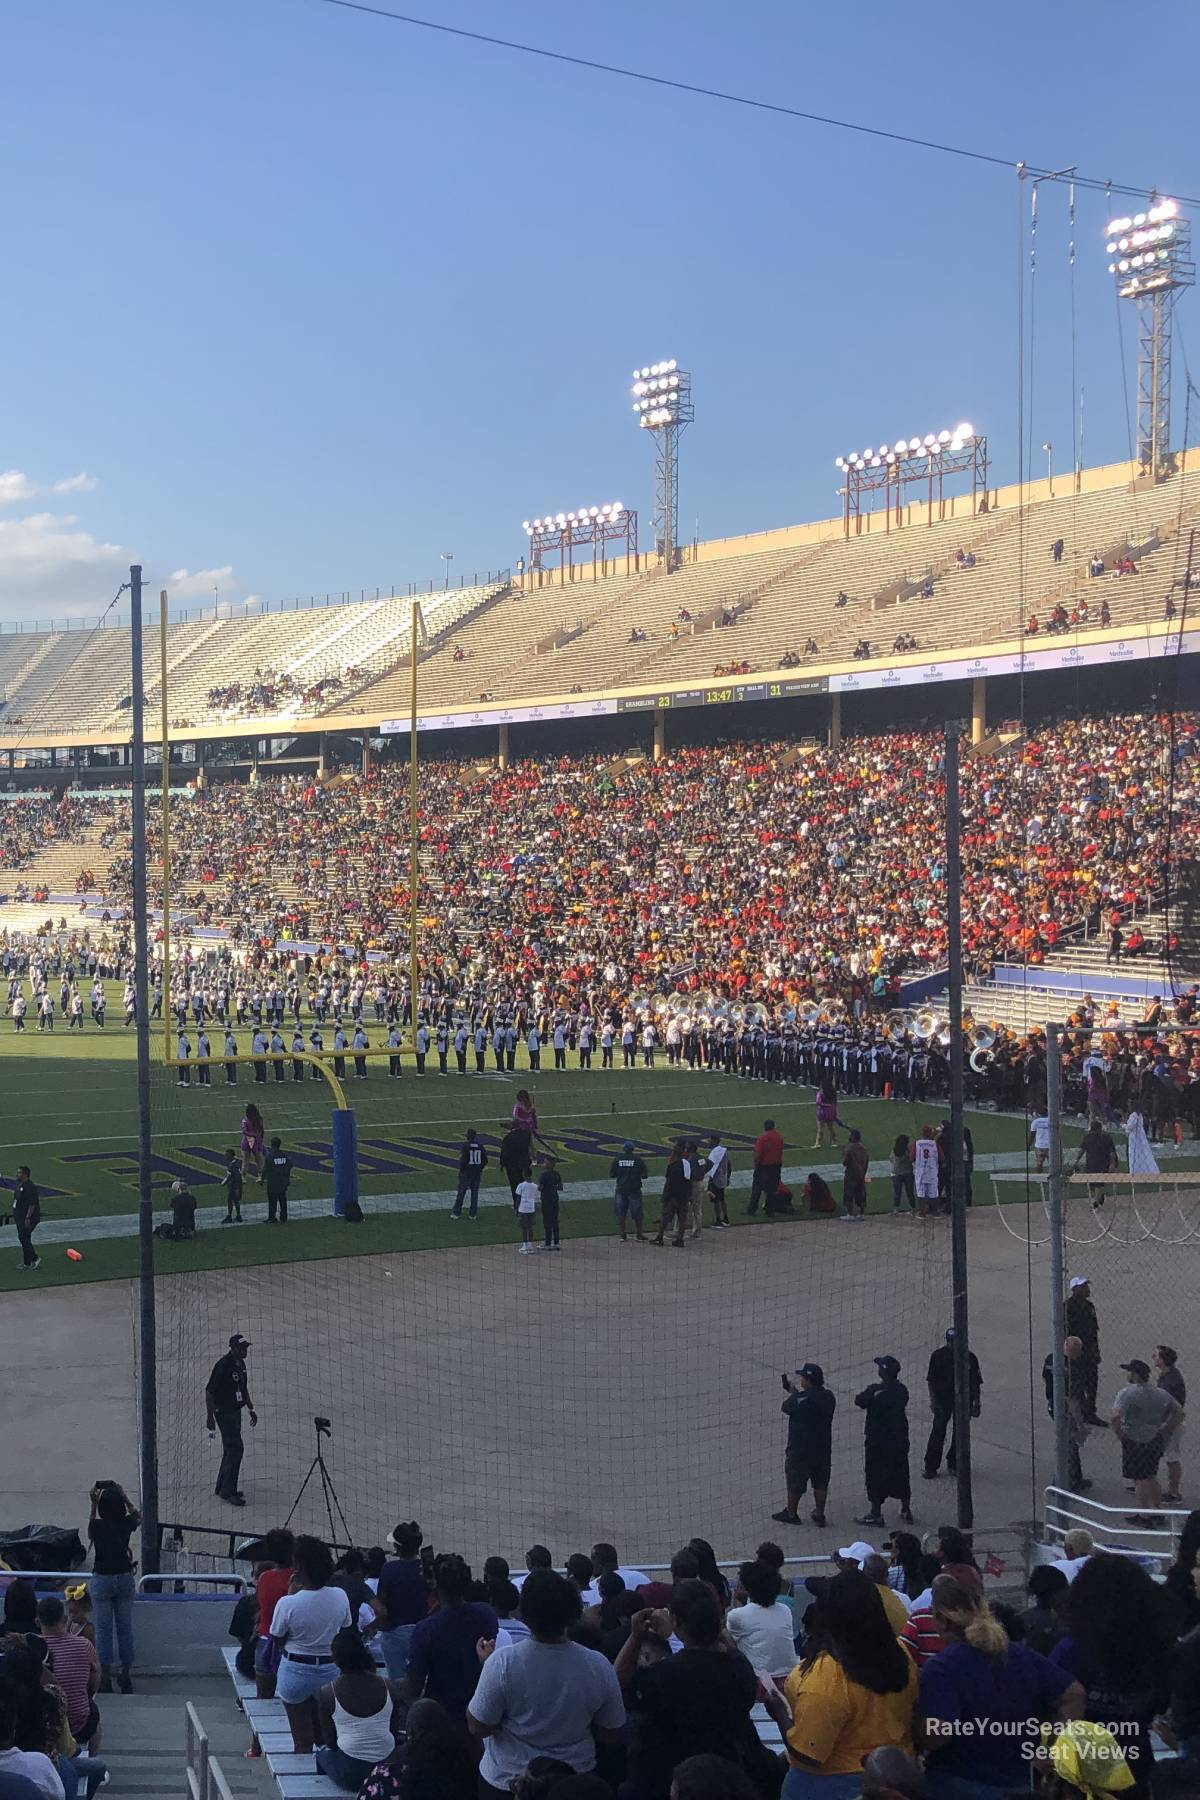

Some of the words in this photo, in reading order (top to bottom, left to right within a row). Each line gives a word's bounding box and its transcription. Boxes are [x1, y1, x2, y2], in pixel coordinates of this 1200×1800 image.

[707, 690, 731, 702] 13:47
[770, 685, 781, 696] 31
[658, 696, 670, 706] 23
[468, 1150, 482, 1165] 10
